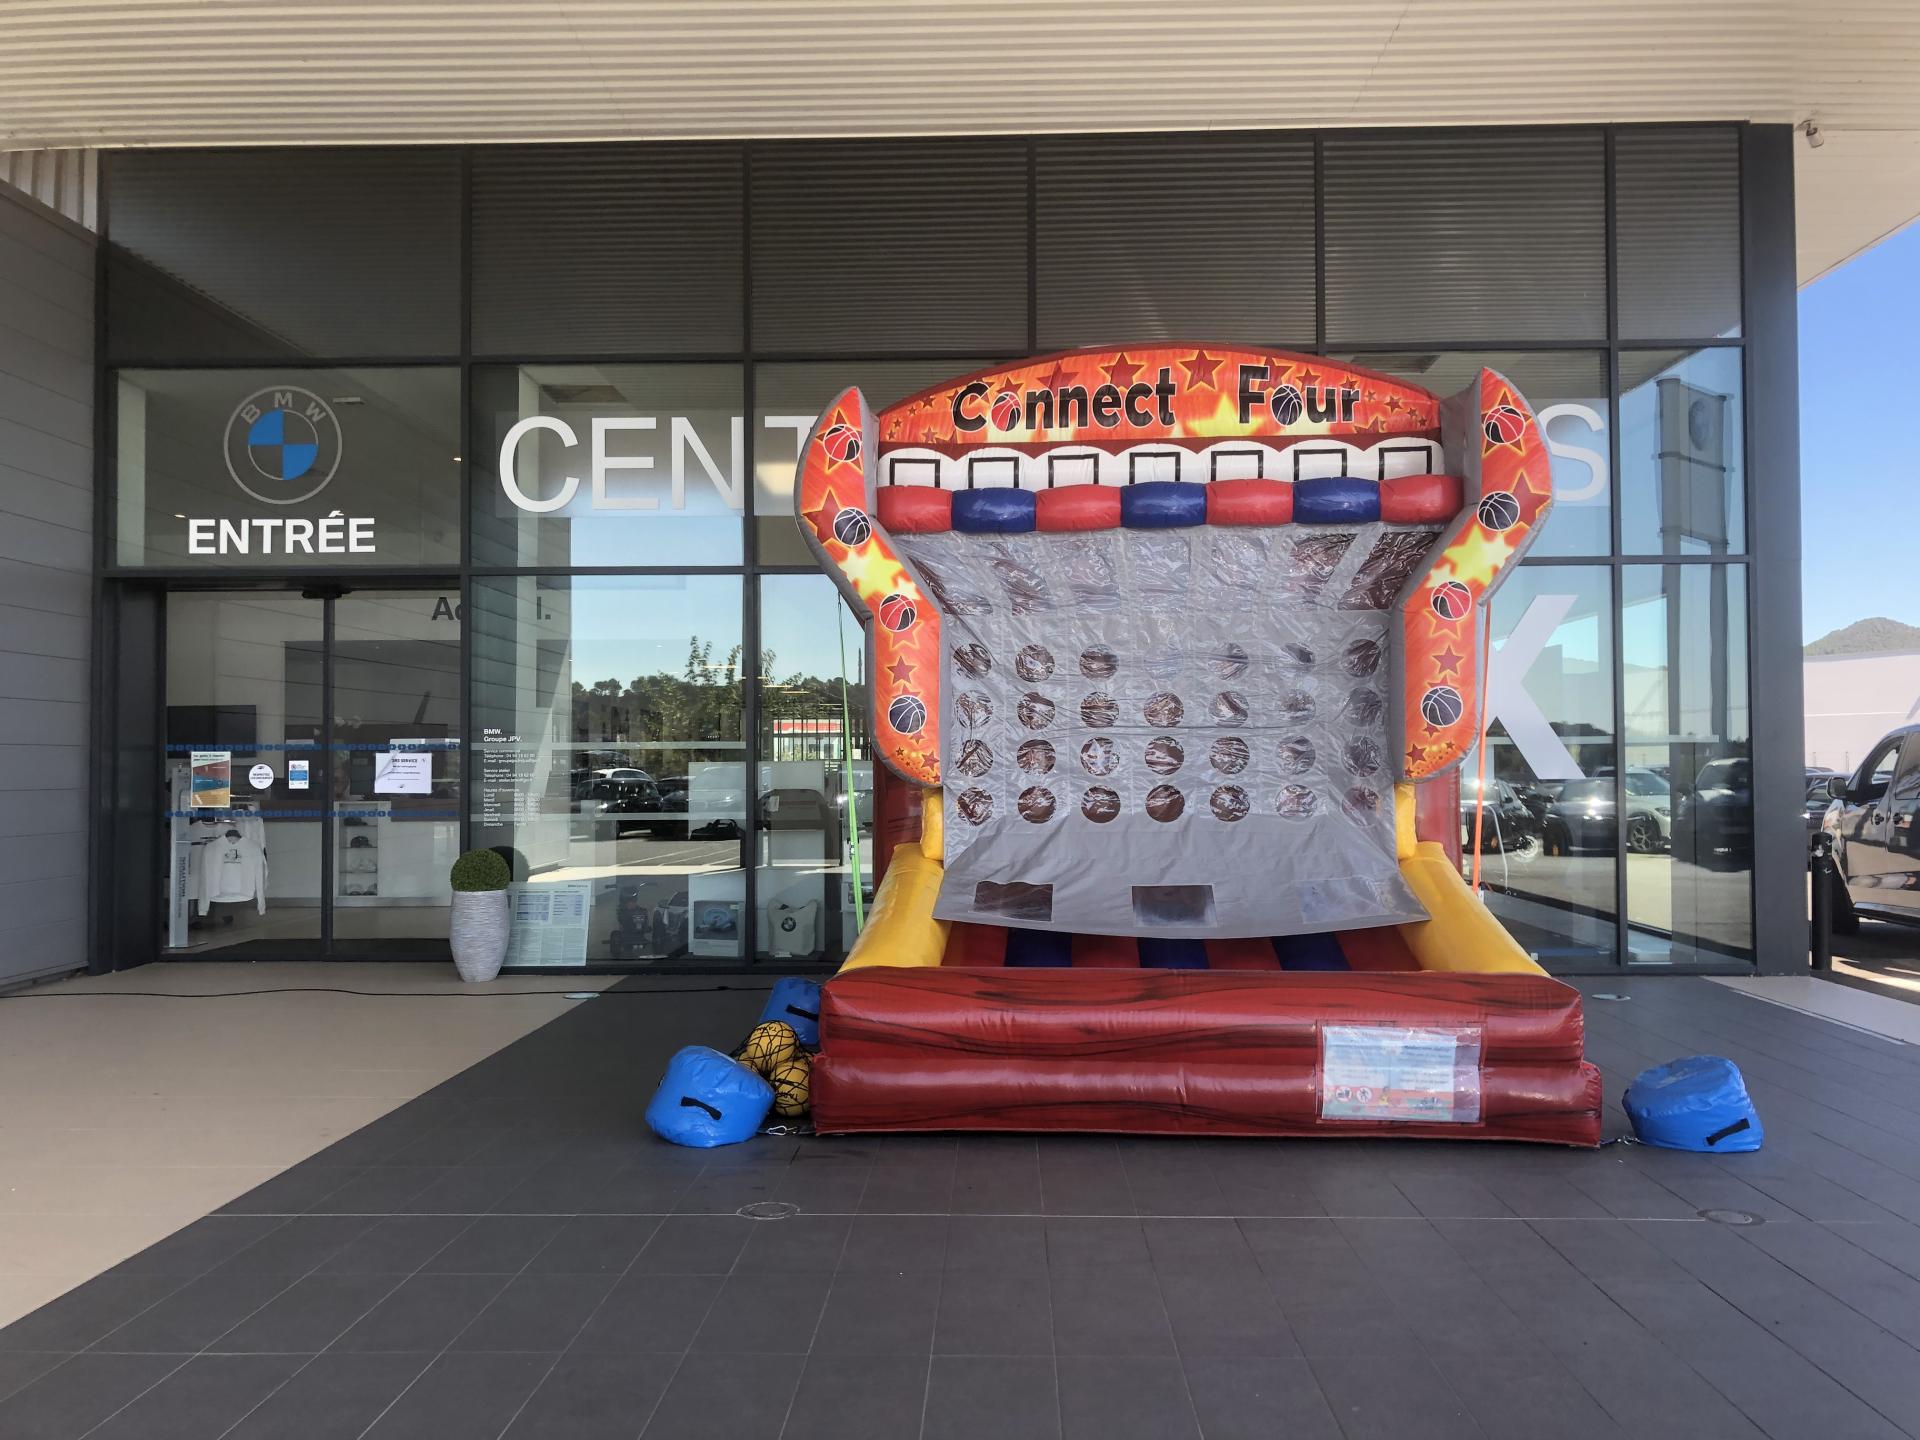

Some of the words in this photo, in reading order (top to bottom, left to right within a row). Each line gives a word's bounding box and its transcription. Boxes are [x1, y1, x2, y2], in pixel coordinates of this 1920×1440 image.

[240, 391, 327, 425] BMW
[951, 365, 1178, 433] Connect
[1238, 363, 1361, 427] Four
[188, 510, 376, 555] ENTRÉE
